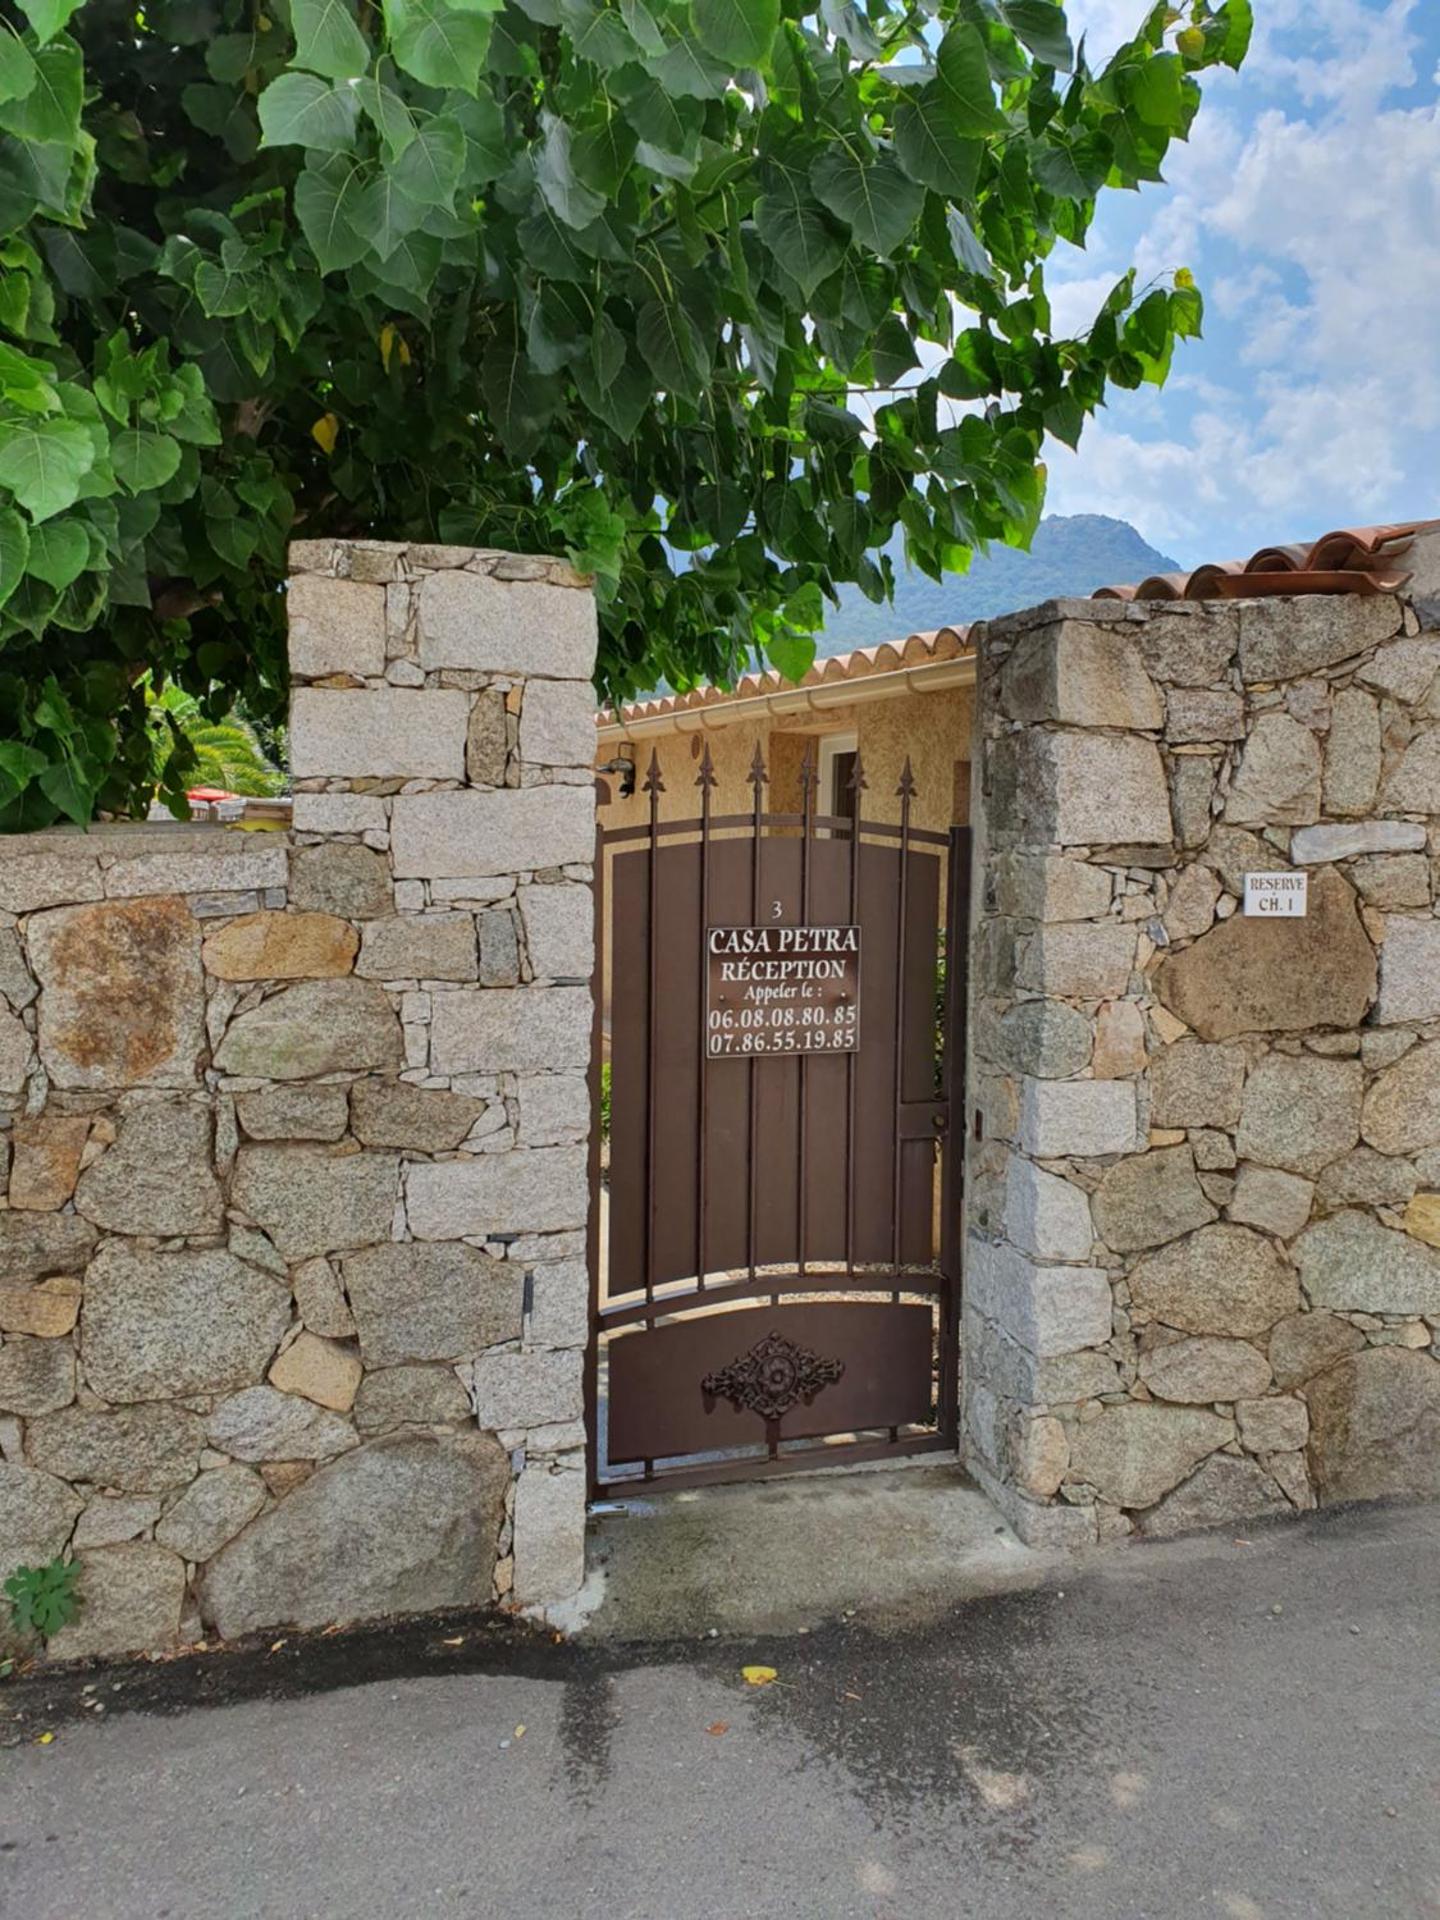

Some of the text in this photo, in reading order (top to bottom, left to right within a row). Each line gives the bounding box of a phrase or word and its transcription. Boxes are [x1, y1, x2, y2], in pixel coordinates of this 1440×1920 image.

[772, 901, 783, 919] 3
[1259, 898, 1283, 911] CH.
[710, 928, 858, 953] CASA PETRA
[720, 957, 846, 981] RÉCEPTION
[744, 982, 798, 1005] Appeler
[709, 1005, 857, 1029] 06.08.08.80.85
[710, 1028, 855, 1053] 07.86.55.19.85
